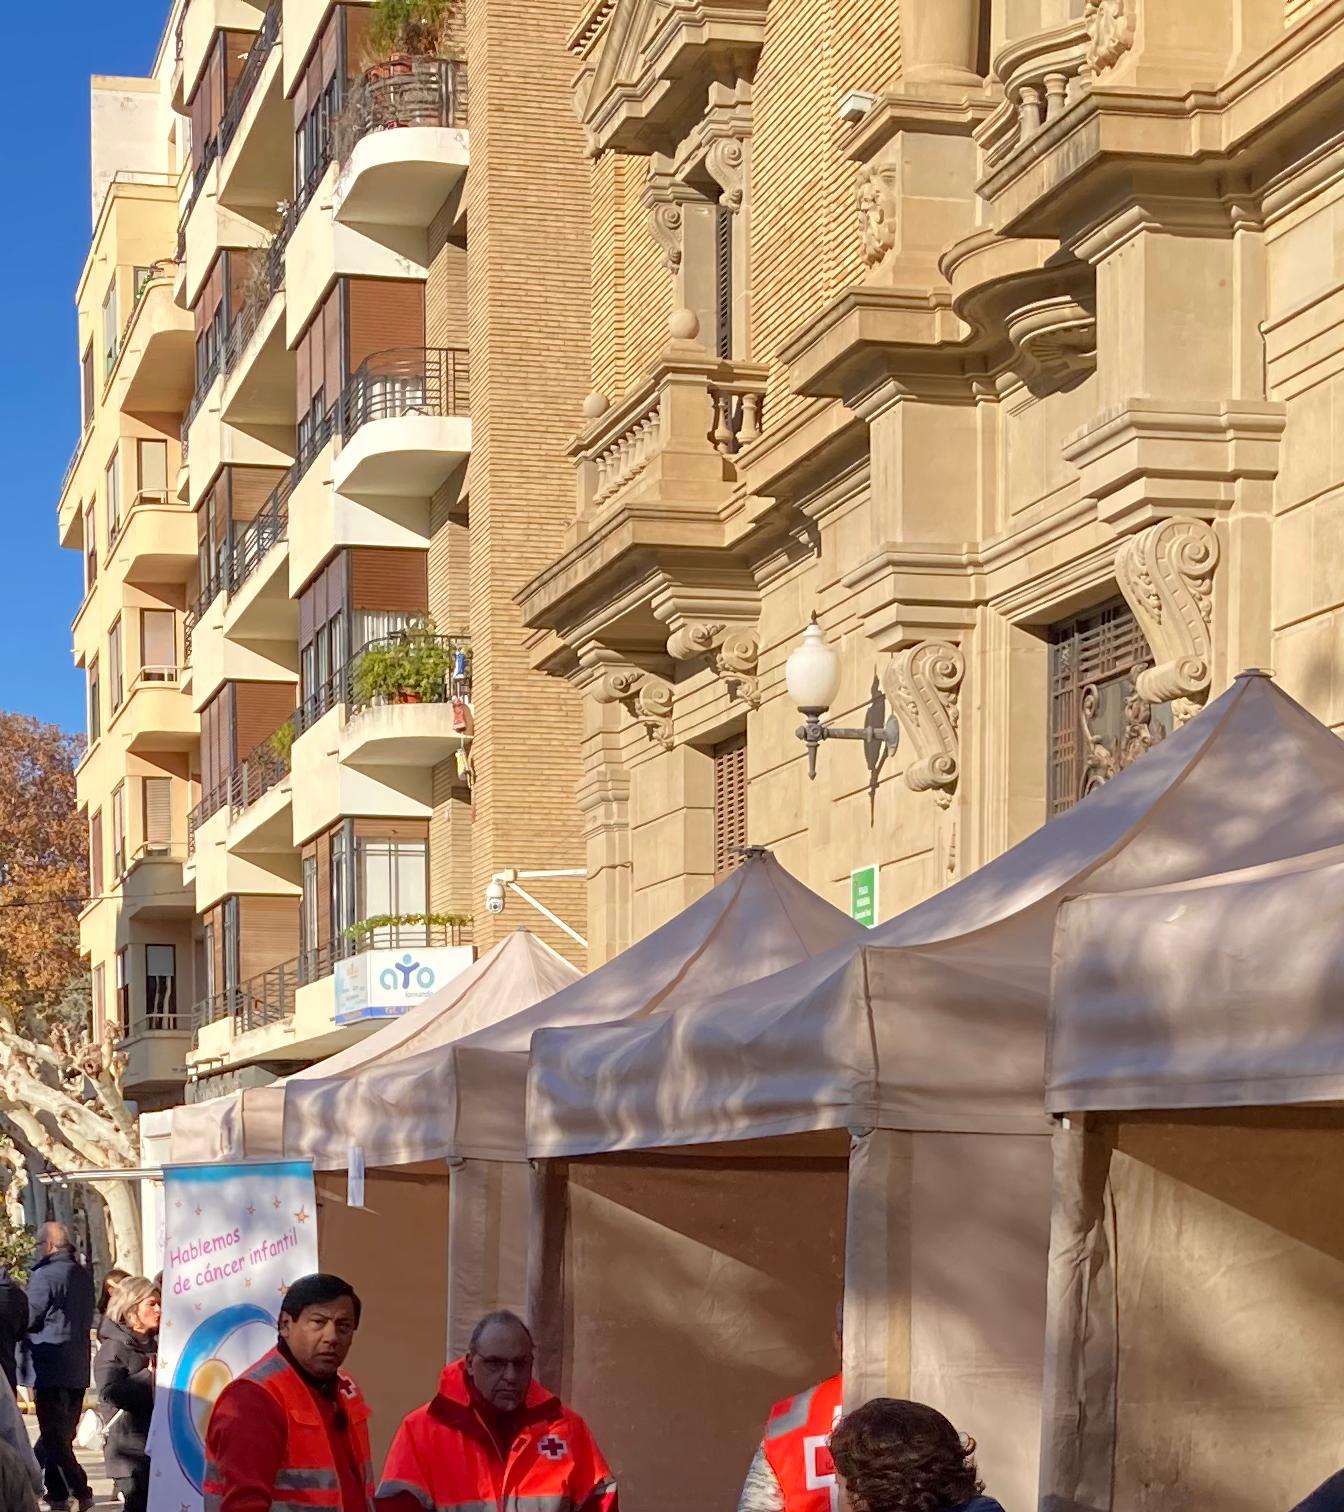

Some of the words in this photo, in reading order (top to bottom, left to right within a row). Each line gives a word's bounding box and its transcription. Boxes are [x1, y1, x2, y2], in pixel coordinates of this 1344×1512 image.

[170, 1227, 241, 1269] Hablemos
[173, 1275, 191, 1295] de
[195, 1262, 245, 1287] cáncer
[249, 1226, 298, 1266] infantil
